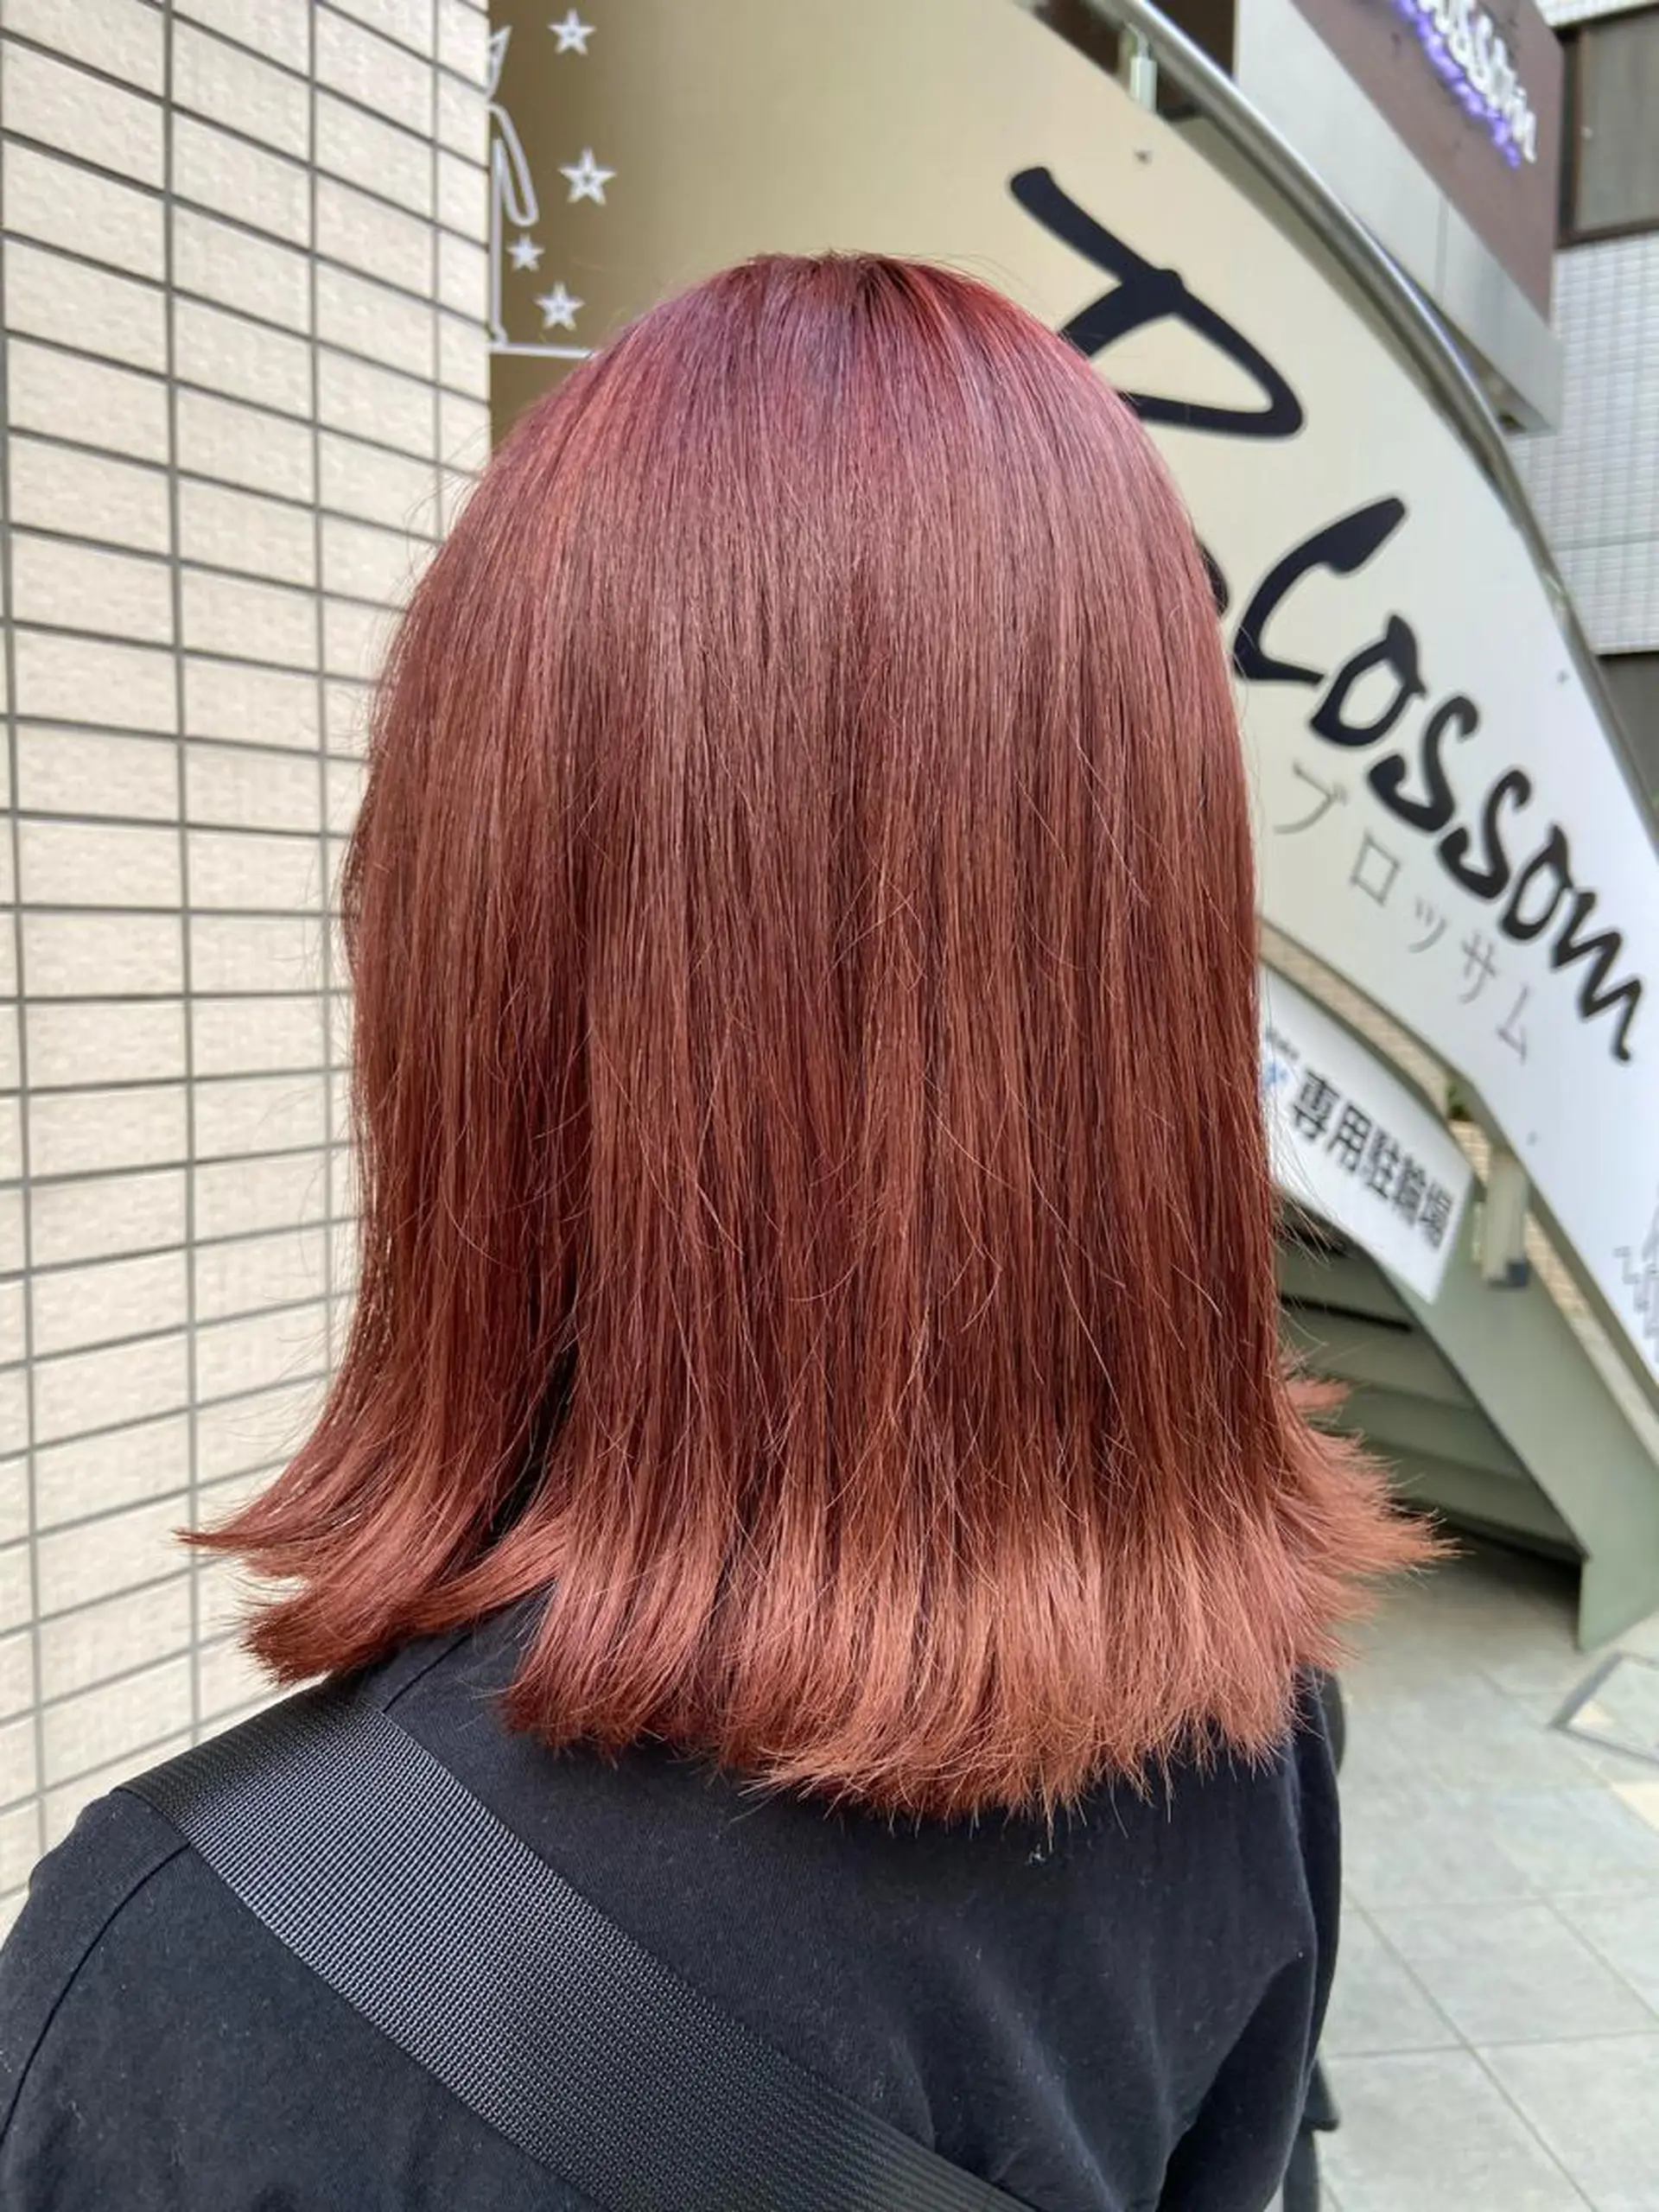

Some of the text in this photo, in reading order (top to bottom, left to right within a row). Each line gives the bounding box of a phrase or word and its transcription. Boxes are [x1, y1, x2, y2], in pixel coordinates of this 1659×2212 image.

[1273, 760, 1529, 1064] ブロッサム
[1292, 1069, 1455, 1251] 専用駐輪場
